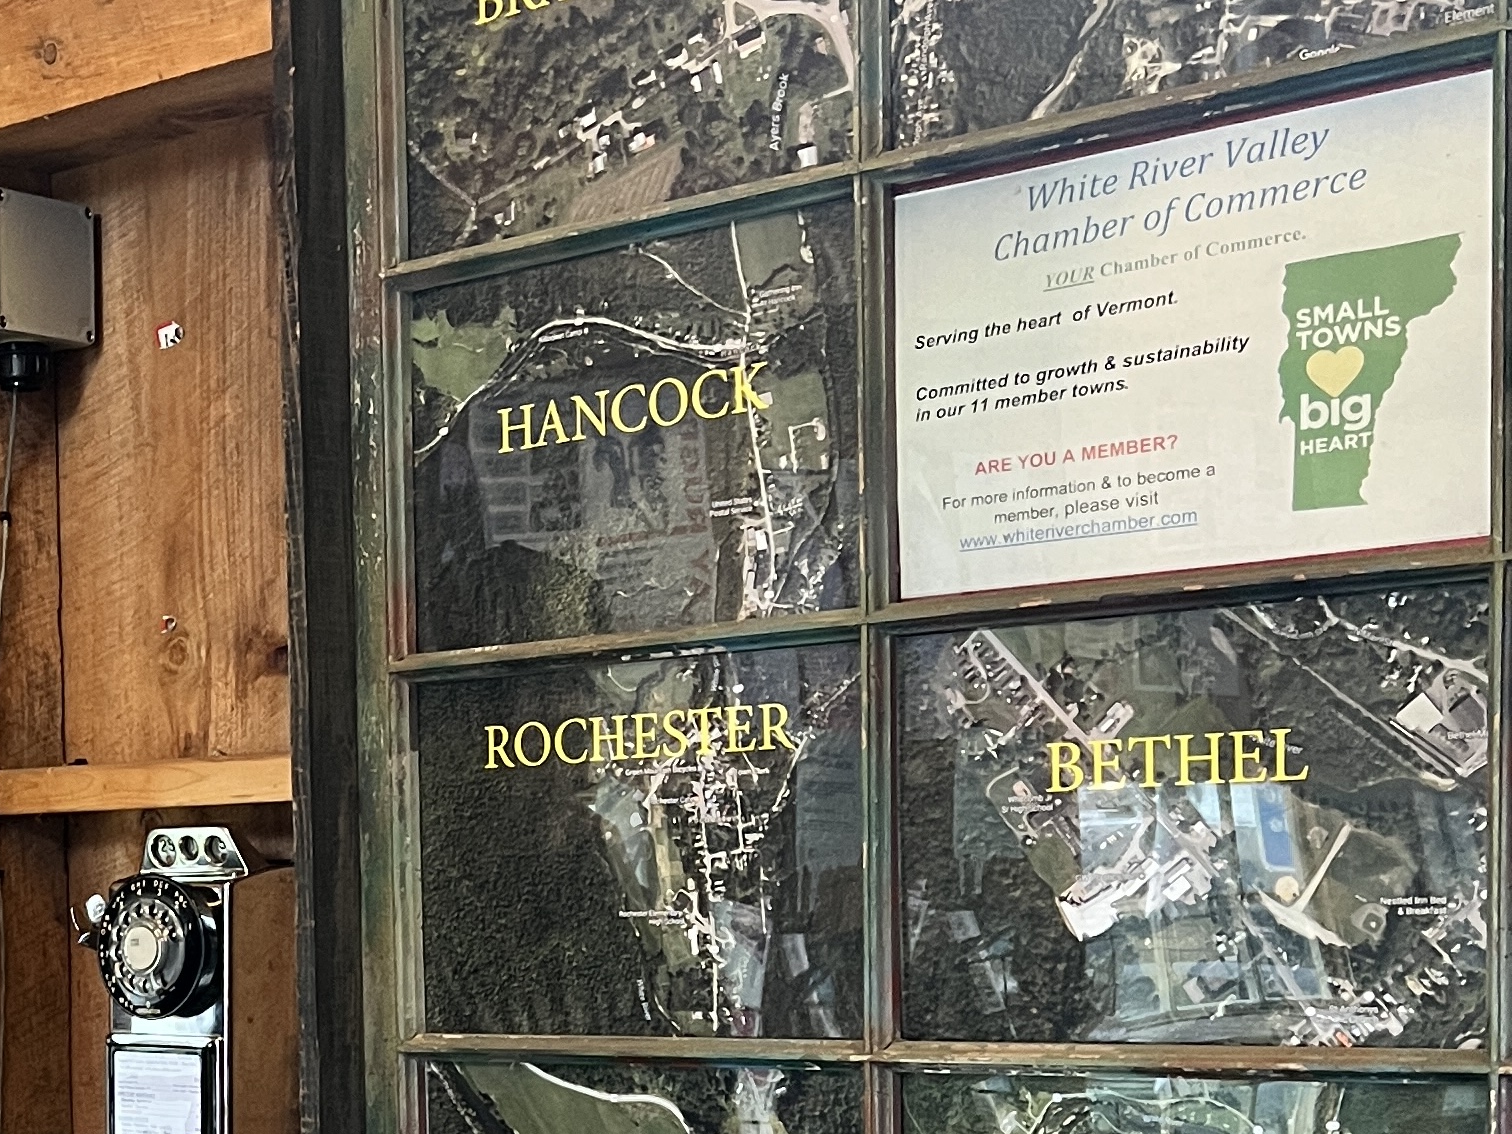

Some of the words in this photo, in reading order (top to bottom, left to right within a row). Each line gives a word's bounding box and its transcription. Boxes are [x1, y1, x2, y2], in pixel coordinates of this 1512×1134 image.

[769, 114, 781, 151] Ayers
[775, 73, 789, 112] Brook
[1027, 172, 1118, 212] White
[1128, 149, 1214, 191] River
[1225, 126, 1331, 169] Valley
[993, 211, 1134, 262] Chamber
[1144, 195, 1182, 238] of
[1184, 167, 1368, 222] Commerce
[1043, 265, 1095, 292] YOUR
[1100, 249, 1178, 278] Chamber
[1184, 245, 1201, 261] of
[1205, 228, 1307, 258] Commerce.
[914, 328, 979, 350] Serving
[984, 321, 1012, 339] the
[1016, 310, 1061, 335] heart
[1072, 305, 1092, 323] of
[1096, 290, 1178, 318] Vermont.
[1296, 296, 1389, 329] SMALL
[1296, 315, 1401, 350] TOWNS
[916, 374, 1009, 402] Committed
[1014, 370, 1030, 385] to
[1036, 360, 1097, 386] growth
[1104, 356, 1117, 371] &
[1122, 336, 1250, 368] sustainability
[498, 361, 770, 454] HANCOCK
[1300, 393, 1372, 430] big
[975, 457, 1012, 475] ARE
[1017, 452, 1057, 470] YOU
[1063, 450, 1075, 463] A
[1082, 434, 1179, 461] MEMBER?
[1300, 432, 1372, 456] HEART
[959, 510, 1198, 552] www.whiteriverchamber.com
[484, 703, 797, 769] ROCHESTER
[1046, 728, 1309, 792] BETHEL
